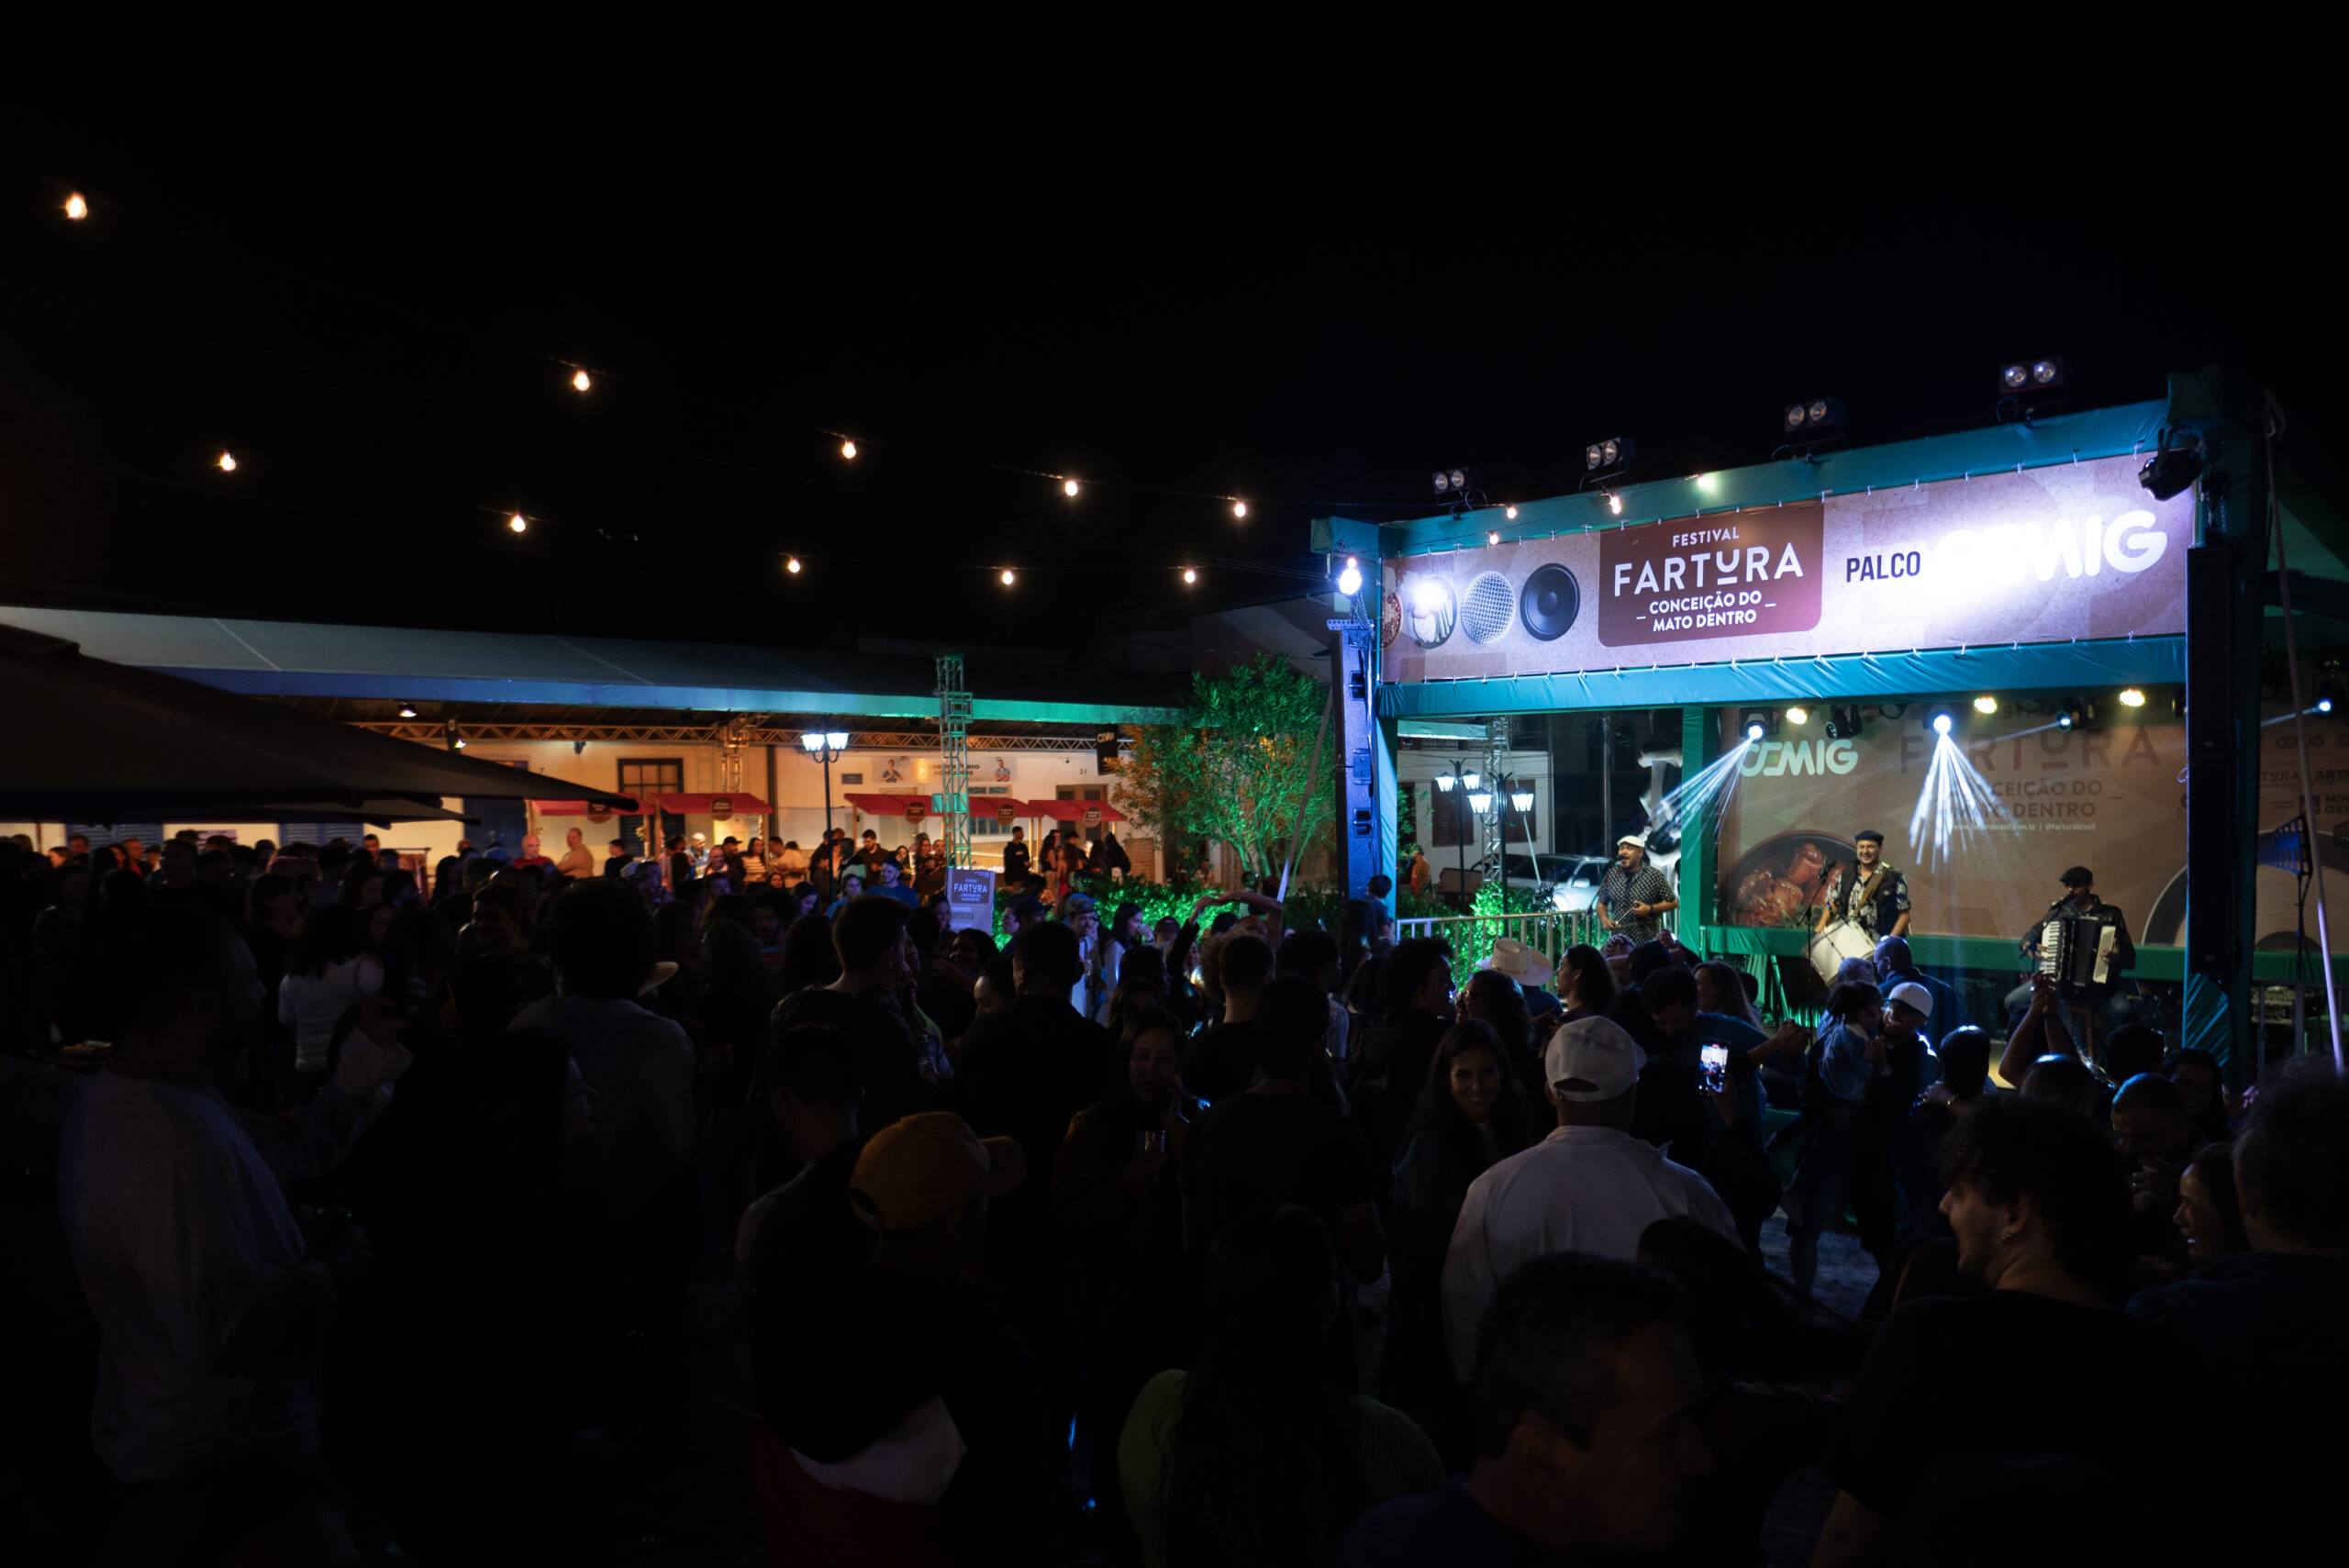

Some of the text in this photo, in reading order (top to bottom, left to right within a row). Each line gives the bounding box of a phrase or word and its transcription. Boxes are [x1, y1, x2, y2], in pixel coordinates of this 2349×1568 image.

[1672, 527, 1740, 548] FESTIVAL
[1845, 509, 2168, 584] PALCO MIG
[1614, 541, 1804, 596] FARTURA
[1649, 590, 1763, 615] CONCEIÇÃO DO
[1653, 609, 1757, 632] MATO DENTRO
[1900, 726, 2162, 773] FRTURA
[2276, 735, 2325, 749] CEIG
[1740, 739, 1859, 777] CEMIG
[1964, 777, 2103, 800] CEIÇÃO DO
[2012, 802, 2097, 818] DENTRO
[953, 883, 987, 893] FARTURA
